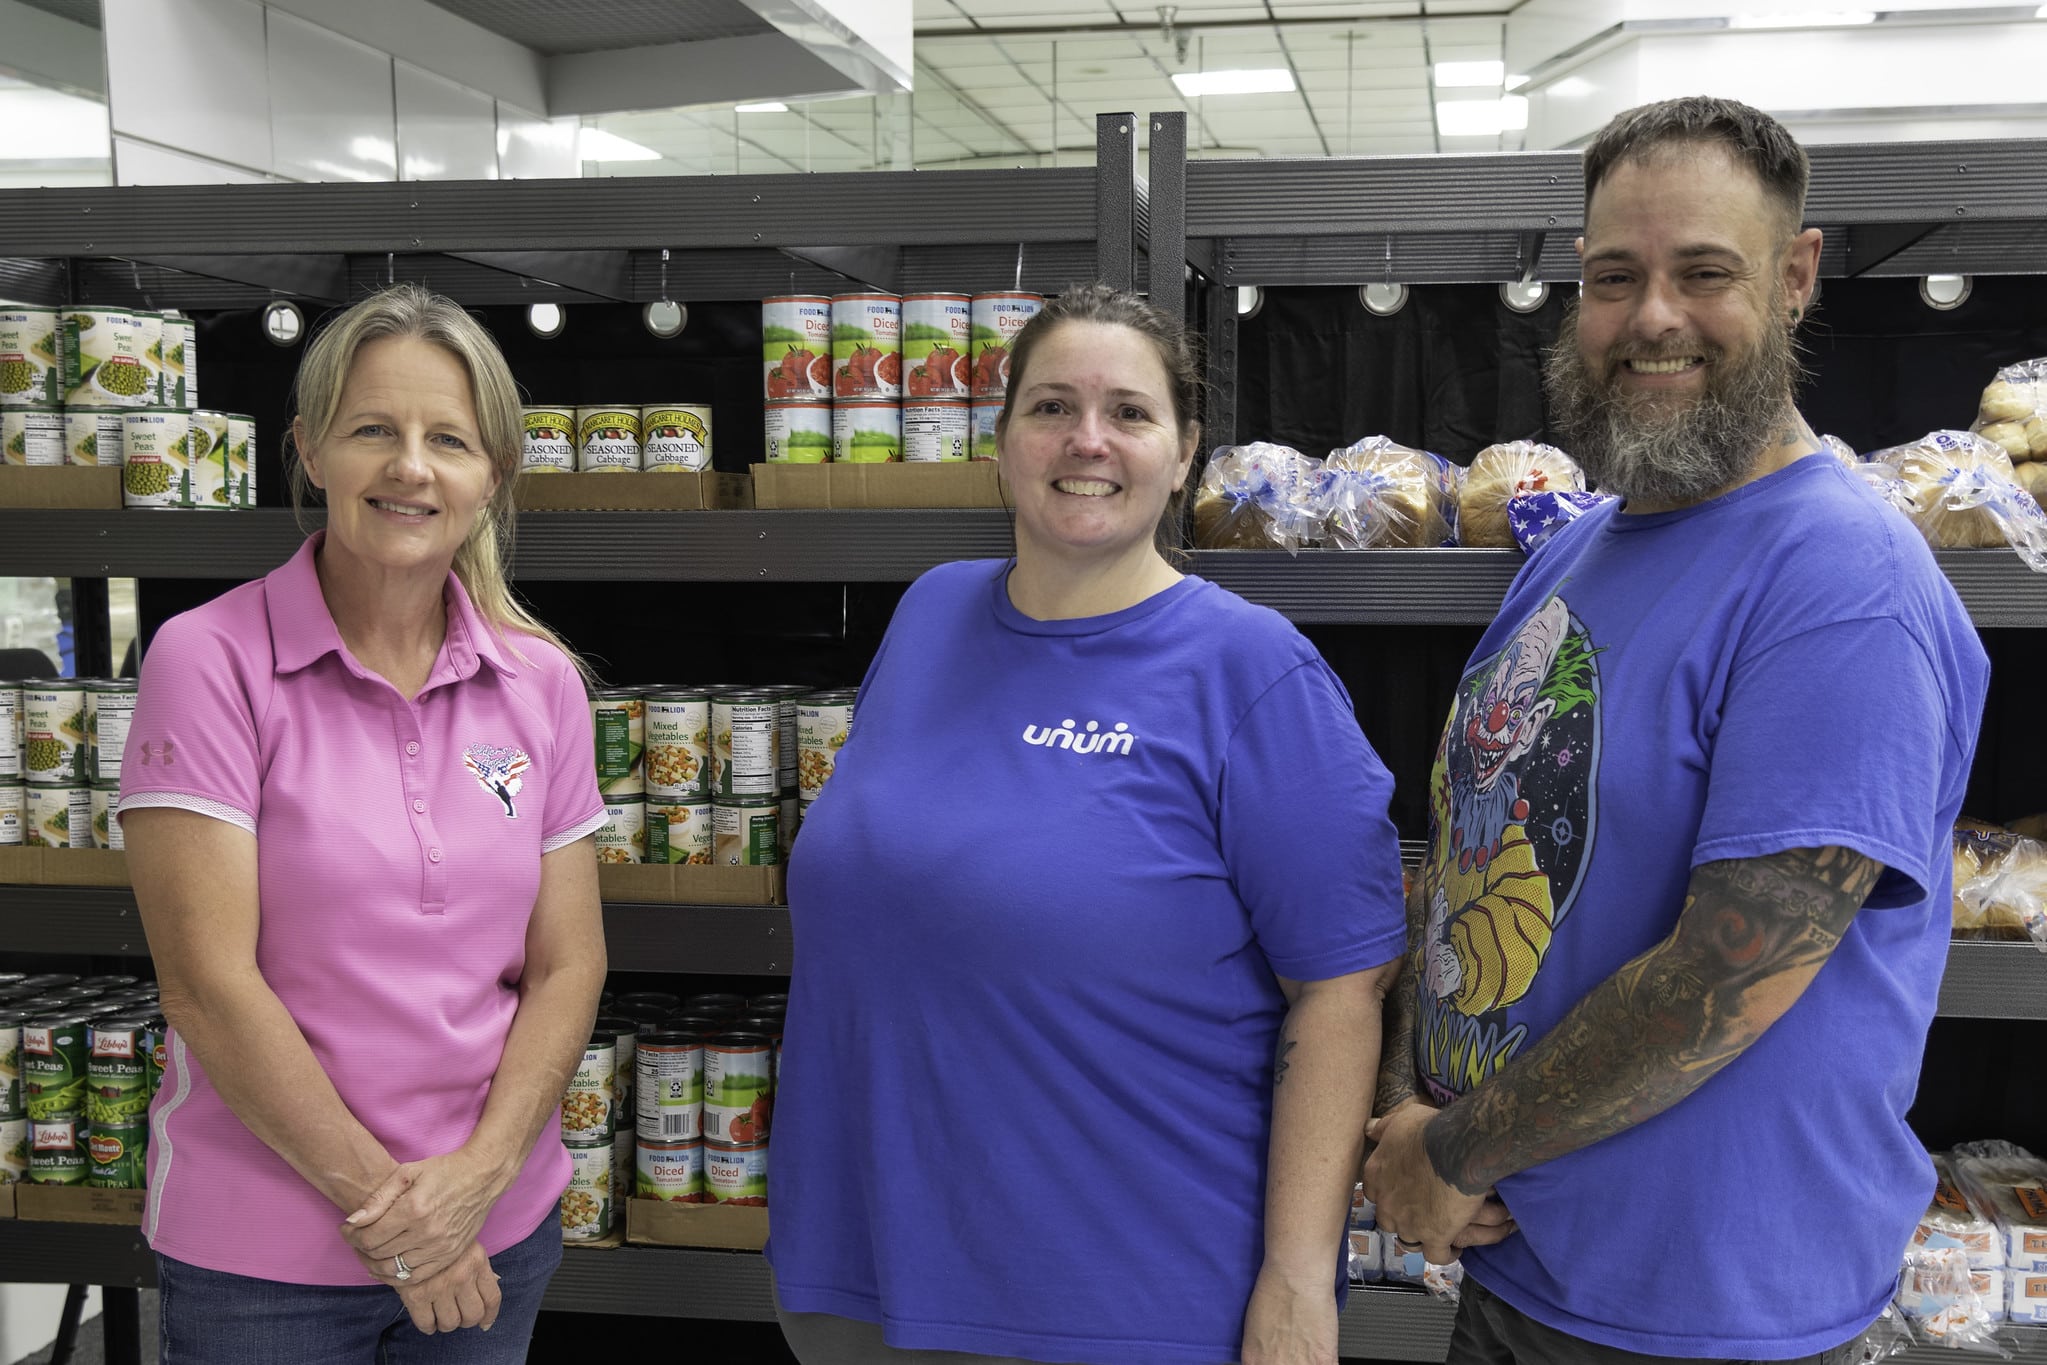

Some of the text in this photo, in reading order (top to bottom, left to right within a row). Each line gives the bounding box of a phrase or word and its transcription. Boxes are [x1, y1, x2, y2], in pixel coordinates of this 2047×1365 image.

[945, 306, 961, 314] FOOD
[1021, 305, 1034, 313] LION
[951, 318, 970, 330] Dice
[149, 416, 165, 424] LION
[585, 414, 616, 430] MARGARET
[645, 413, 701, 431] MARGARET HOLMES
[130, 431, 156, 441] Sweet
[134, 442, 155, 451] Peas
[524, 445, 572, 455] EASONED
[586, 445, 640, 455] SEASONED
[646, 443, 699, 453] SEASONED
[528, 454, 564, 465] Cabbage
[596, 454, 632, 465] Cabbage
[655, 453, 689, 465] Cabbage
[648, 705, 661, 713] FOOD
[807, 710, 820, 718] LION
[30, 719, 47, 728] Peas
[652, 721, 678, 731] Mixed
[608, 808, 623, 816] LION
[597, 834, 627, 844] etables
[99, 1037, 128, 1052] Libby's
[37, 1061, 64, 1072] Peas
[117, 1063, 144, 1073] Peas
[40, 1129, 68, 1144] Libby's
[98, 1144, 121, 1153] Monte
[57, 1156, 85, 1166] Peas
[649, 1154, 665, 1162] FOOD
[707, 1154, 745, 1164] FOOD LION
[654, 1165, 684, 1176] Diced
[711, 1165, 739, 1177] Diced
[712, 1176, 738, 1185] Tomatoes
